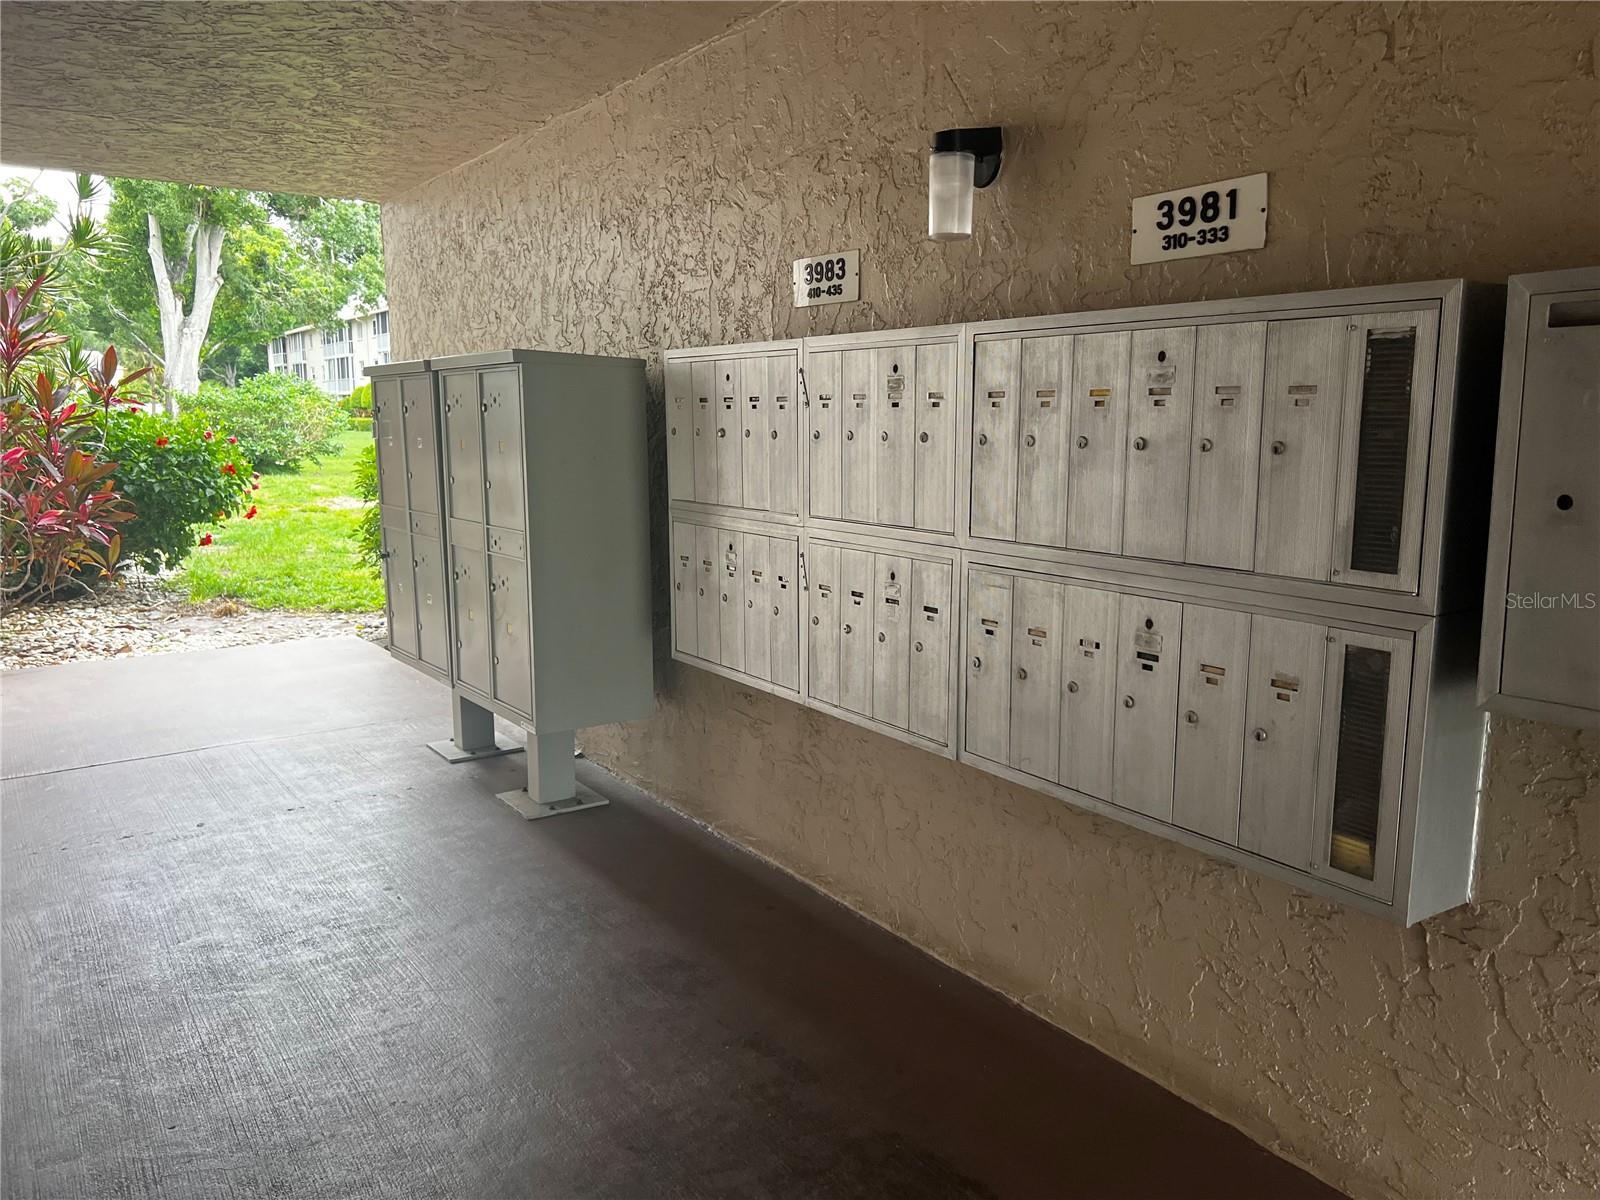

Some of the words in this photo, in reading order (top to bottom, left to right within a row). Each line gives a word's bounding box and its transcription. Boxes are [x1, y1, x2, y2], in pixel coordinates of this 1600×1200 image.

[1156, 188, 1238, 231] 3981
[1162, 226, 1230, 251] 310-333
[804, 258, 846, 285] 3983
[807, 284, 843, 299] 410-435
